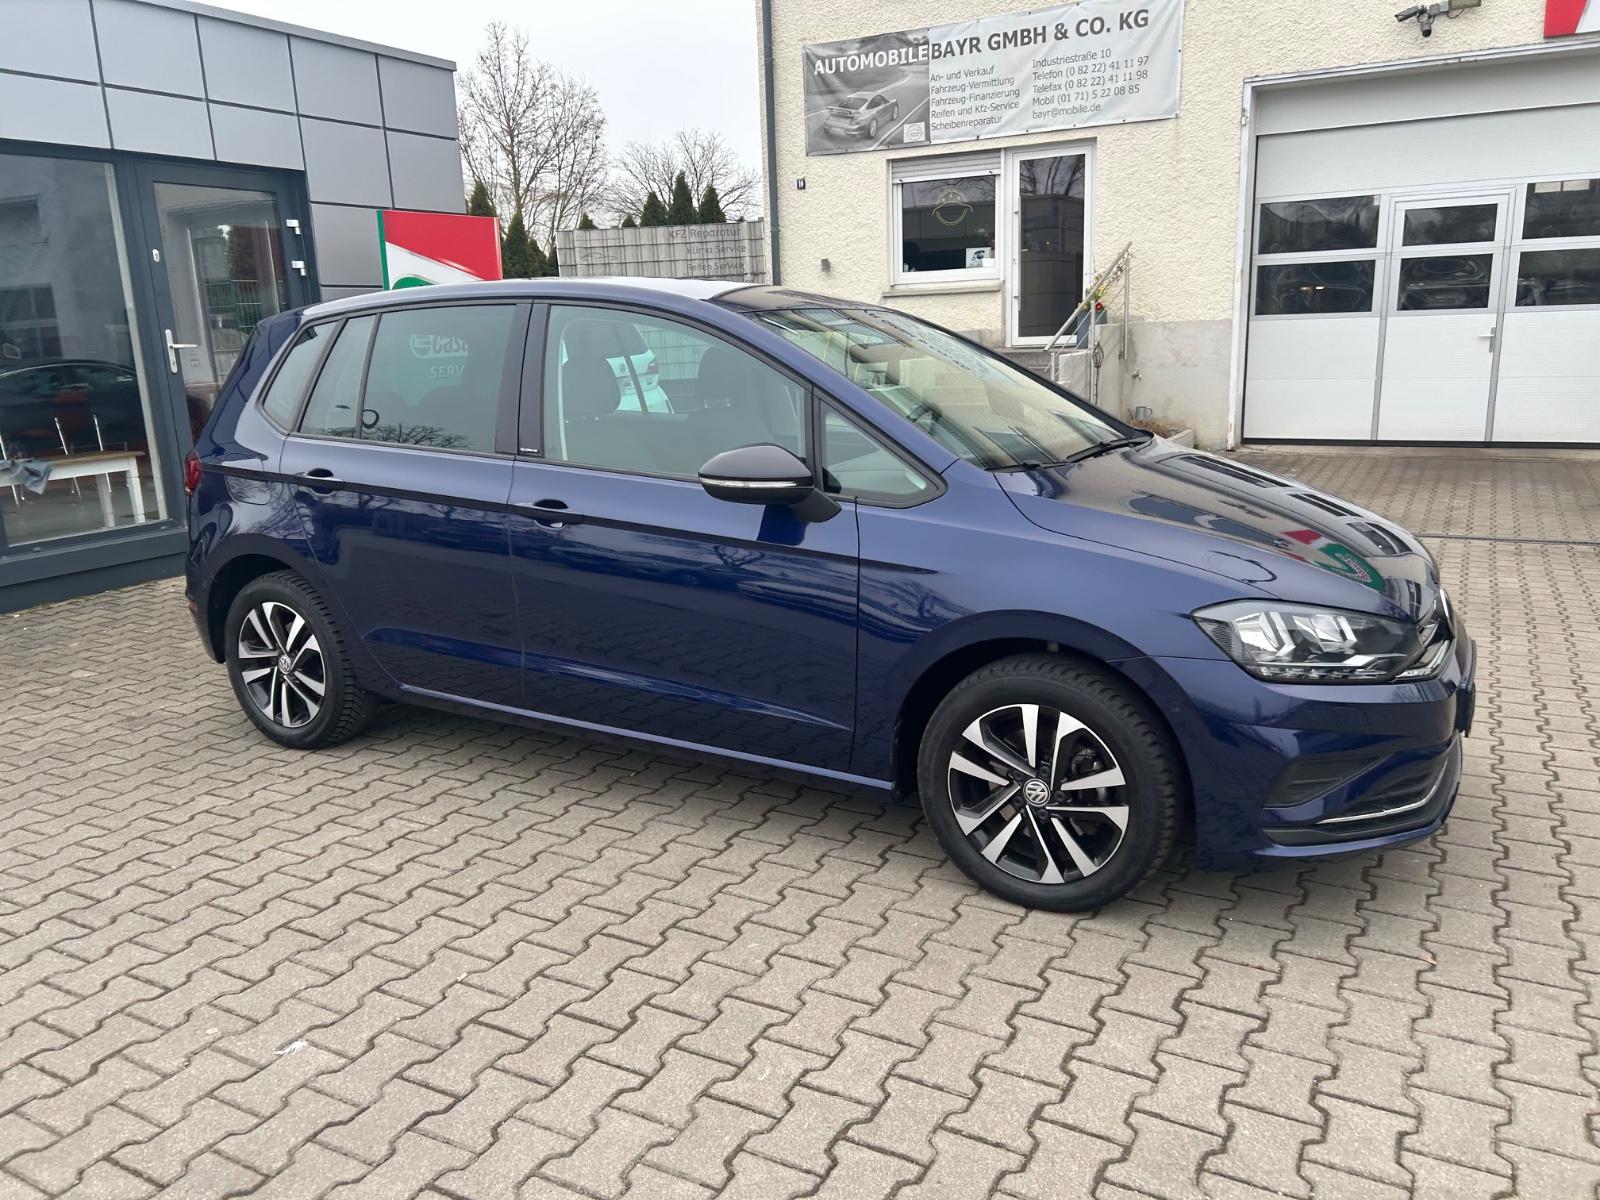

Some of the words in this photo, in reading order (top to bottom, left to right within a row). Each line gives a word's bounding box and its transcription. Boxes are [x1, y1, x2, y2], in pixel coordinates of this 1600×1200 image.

[813, 44, 929, 75] AUTOMOBILE
[931, 36, 982, 60] BAYR
[987, 25, 1047, 51] GMBH
[1053, 22, 1069, 41] &
[1075, 16, 1111, 37] CO.
[1119, 8, 1149, 31] KG
[1032, 50, 1098, 68] Industriestraße
[1100, 48, 1112, 59] 10
[930, 74, 944, 82] An-
[946, 71, 961, 80] und
[963, 64, 995, 78] Verkauf
[1033, 70, 1063, 81] Telefon
[1065, 66, 1075, 77] (0
[1077, 65, 1089, 75] 82
[1091, 62, 1107, 74] 22)
[1109, 60, 1121, 70] 41
[1124, 58, 1134, 68] 11
[1137, 55, 1150, 67] 97
[930, 76, 1015, 95] Fahrzeug-Vermittlung
[1033, 83, 1062, 93] Telefax
[1064, 79, 1074, 91] (0
[1076, 78, 1088, 88] 82
[1090, 75, 1106, 87] 22)
[1108, 74, 1120, 83] 41
[1123, 72, 1133, 82] 11
[1136, 69, 1149, 80] 98
[930, 88, 1021, 107] Fahrzeug-Finanzierung
[1032, 95, 1055, 106] Mobil
[1057, 93, 1072, 105] (01
[1075, 91, 1089, 102] 71)
[1092, 90, 1098, 99] 5
[1100, 88, 1111, 98] 22
[1113, 86, 1126, 96] 08
[1128, 84, 1141, 94] 85
[931, 109, 956, 119] Reifen
[958, 106, 973, 116] und
[975, 101, 1020, 114] Kfz-Service
[1032, 103, 1102, 120] bayr@mobile.de
[931, 116, 1003, 131] Scheibenreparatur
[690, 227, 740, 240] Reparatur
